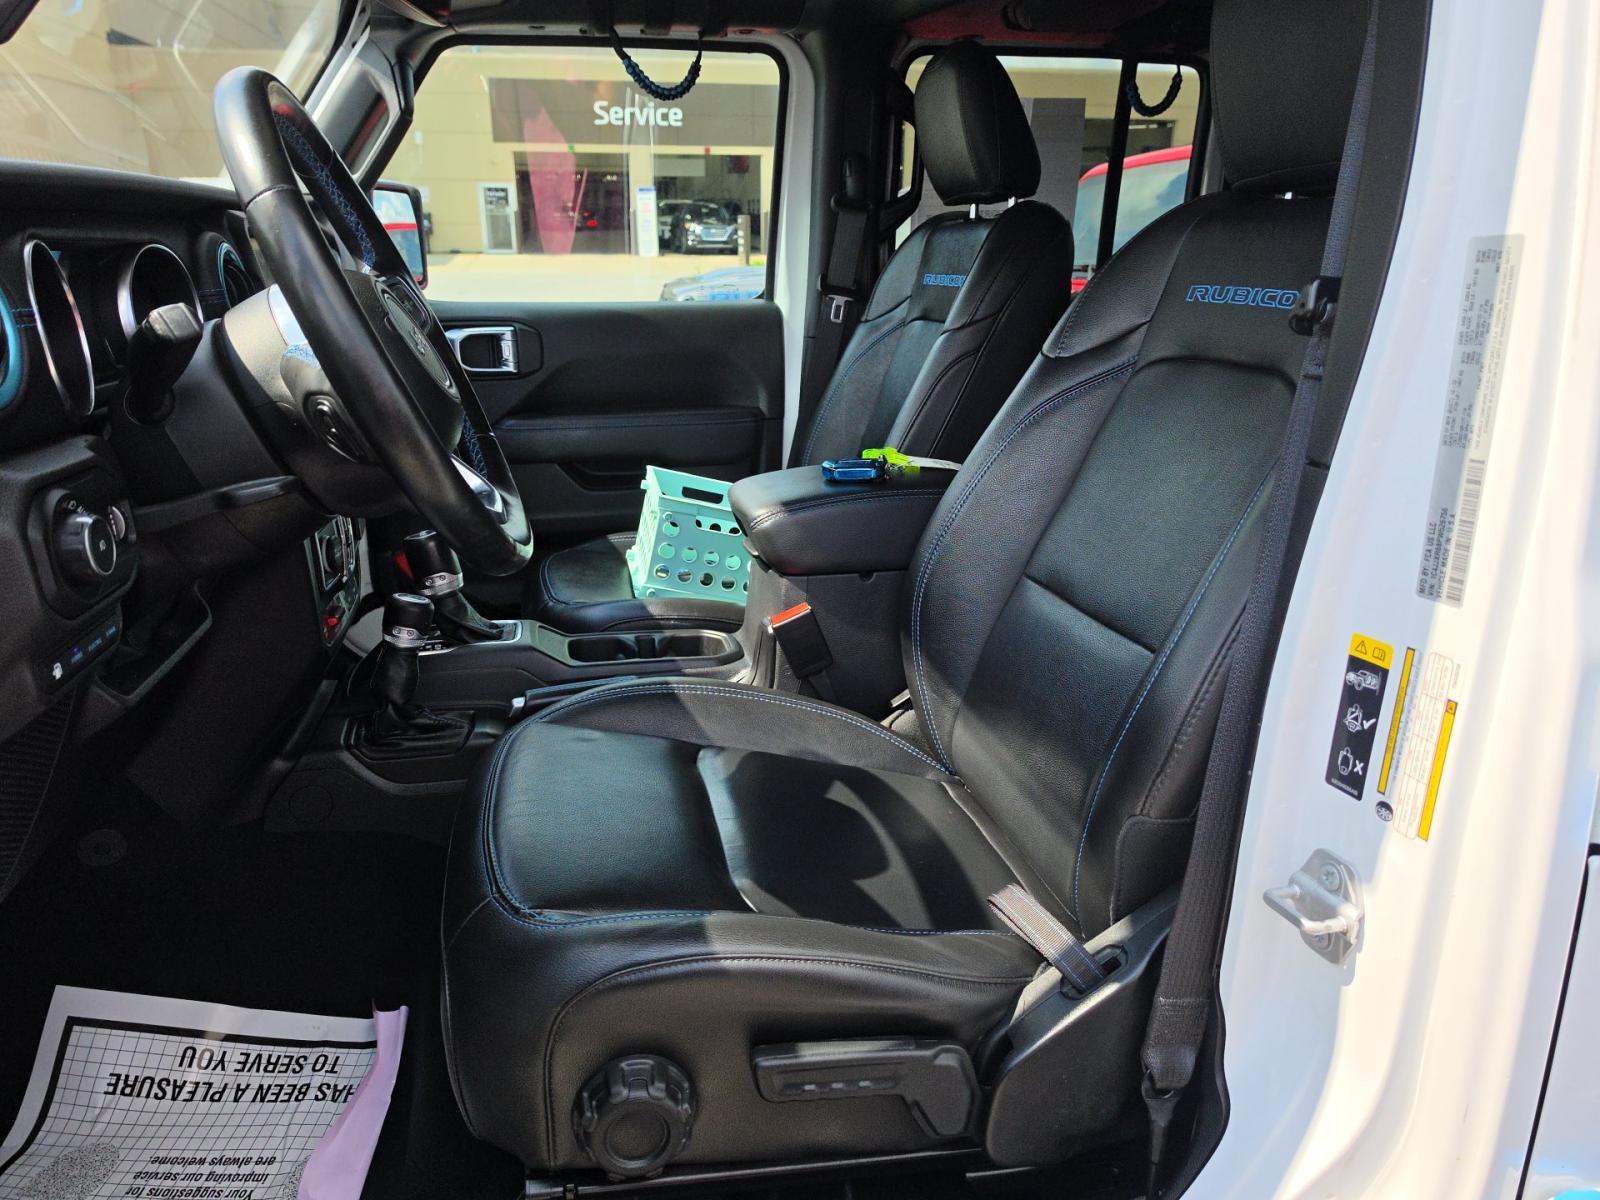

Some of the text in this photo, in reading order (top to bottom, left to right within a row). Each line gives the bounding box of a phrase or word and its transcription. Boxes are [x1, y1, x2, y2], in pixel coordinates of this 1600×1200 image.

[593, 100, 683, 127] Service
[178, 1046, 340, 1074] TO SERVE YOU
[104, 1072, 226, 1103] PLEASURE
[234, 1082, 252, 1102] A
[251, 1082, 310, 1104] BEEN
[208, 1154, 251, 1168] always
[254, 1156, 277, 1166] are
[133, 1170, 269, 1184] improving our service
[125, 1186, 254, 1200] Your suggestions for
